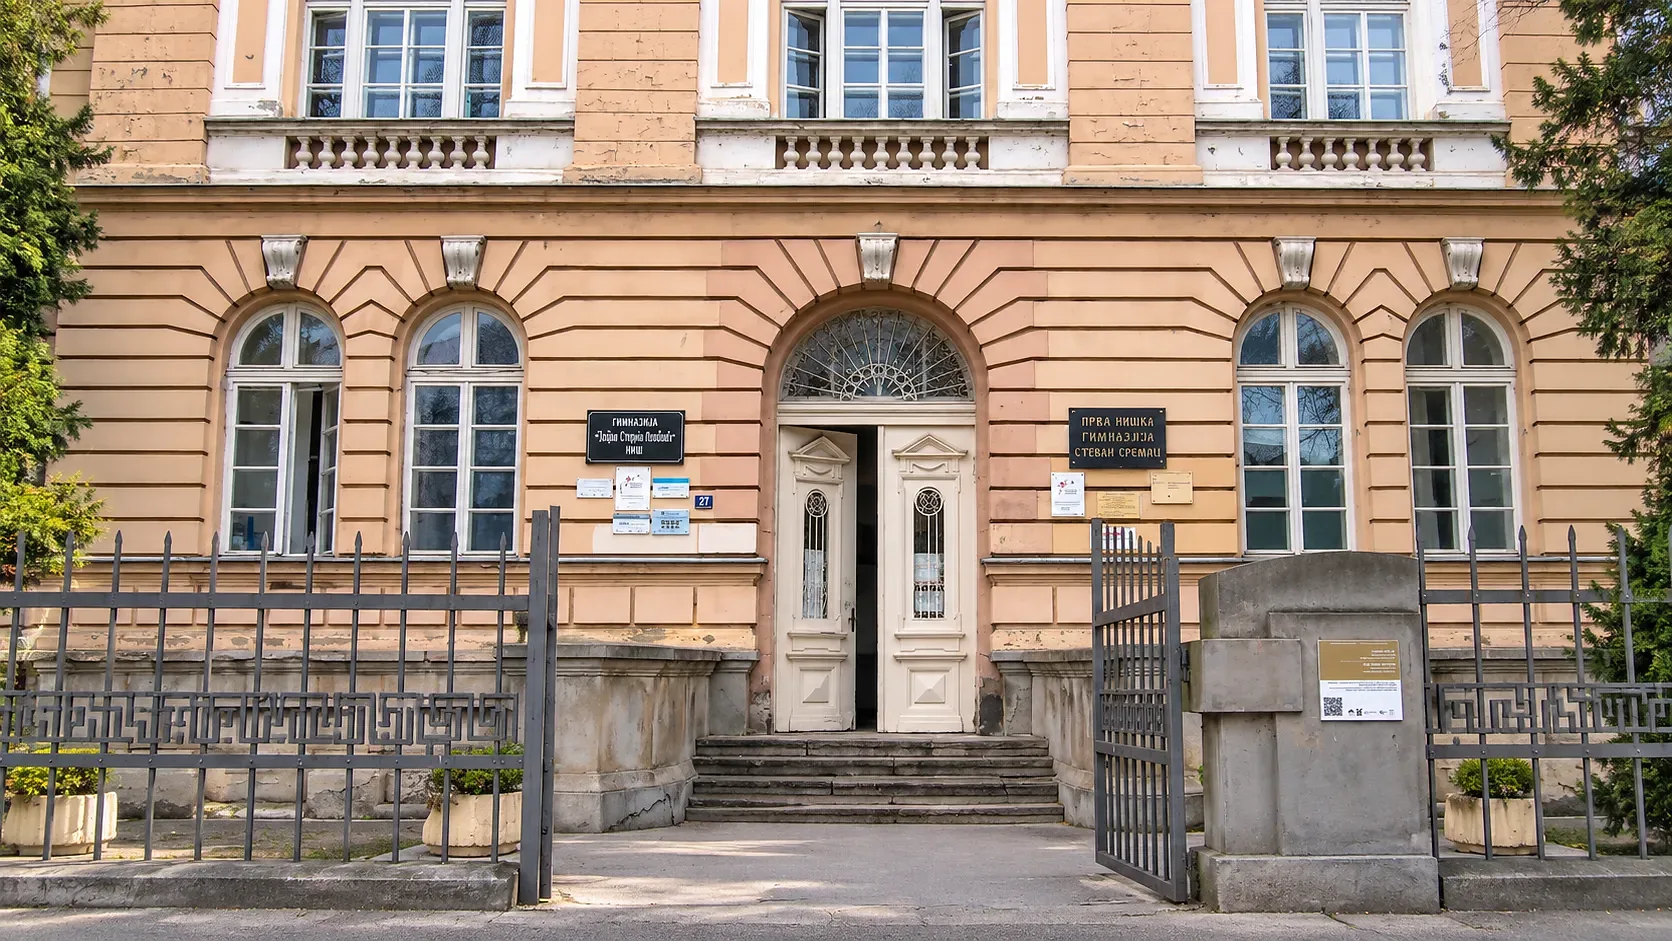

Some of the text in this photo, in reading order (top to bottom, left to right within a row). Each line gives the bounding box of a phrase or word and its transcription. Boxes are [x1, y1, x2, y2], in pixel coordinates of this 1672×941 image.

[1081, 416, 1154, 427] ПРВА НИШКА
[1074, 447, 1161, 458] СТЕВАН СРЕМАЦ
[698, 496, 710, 506] 27
